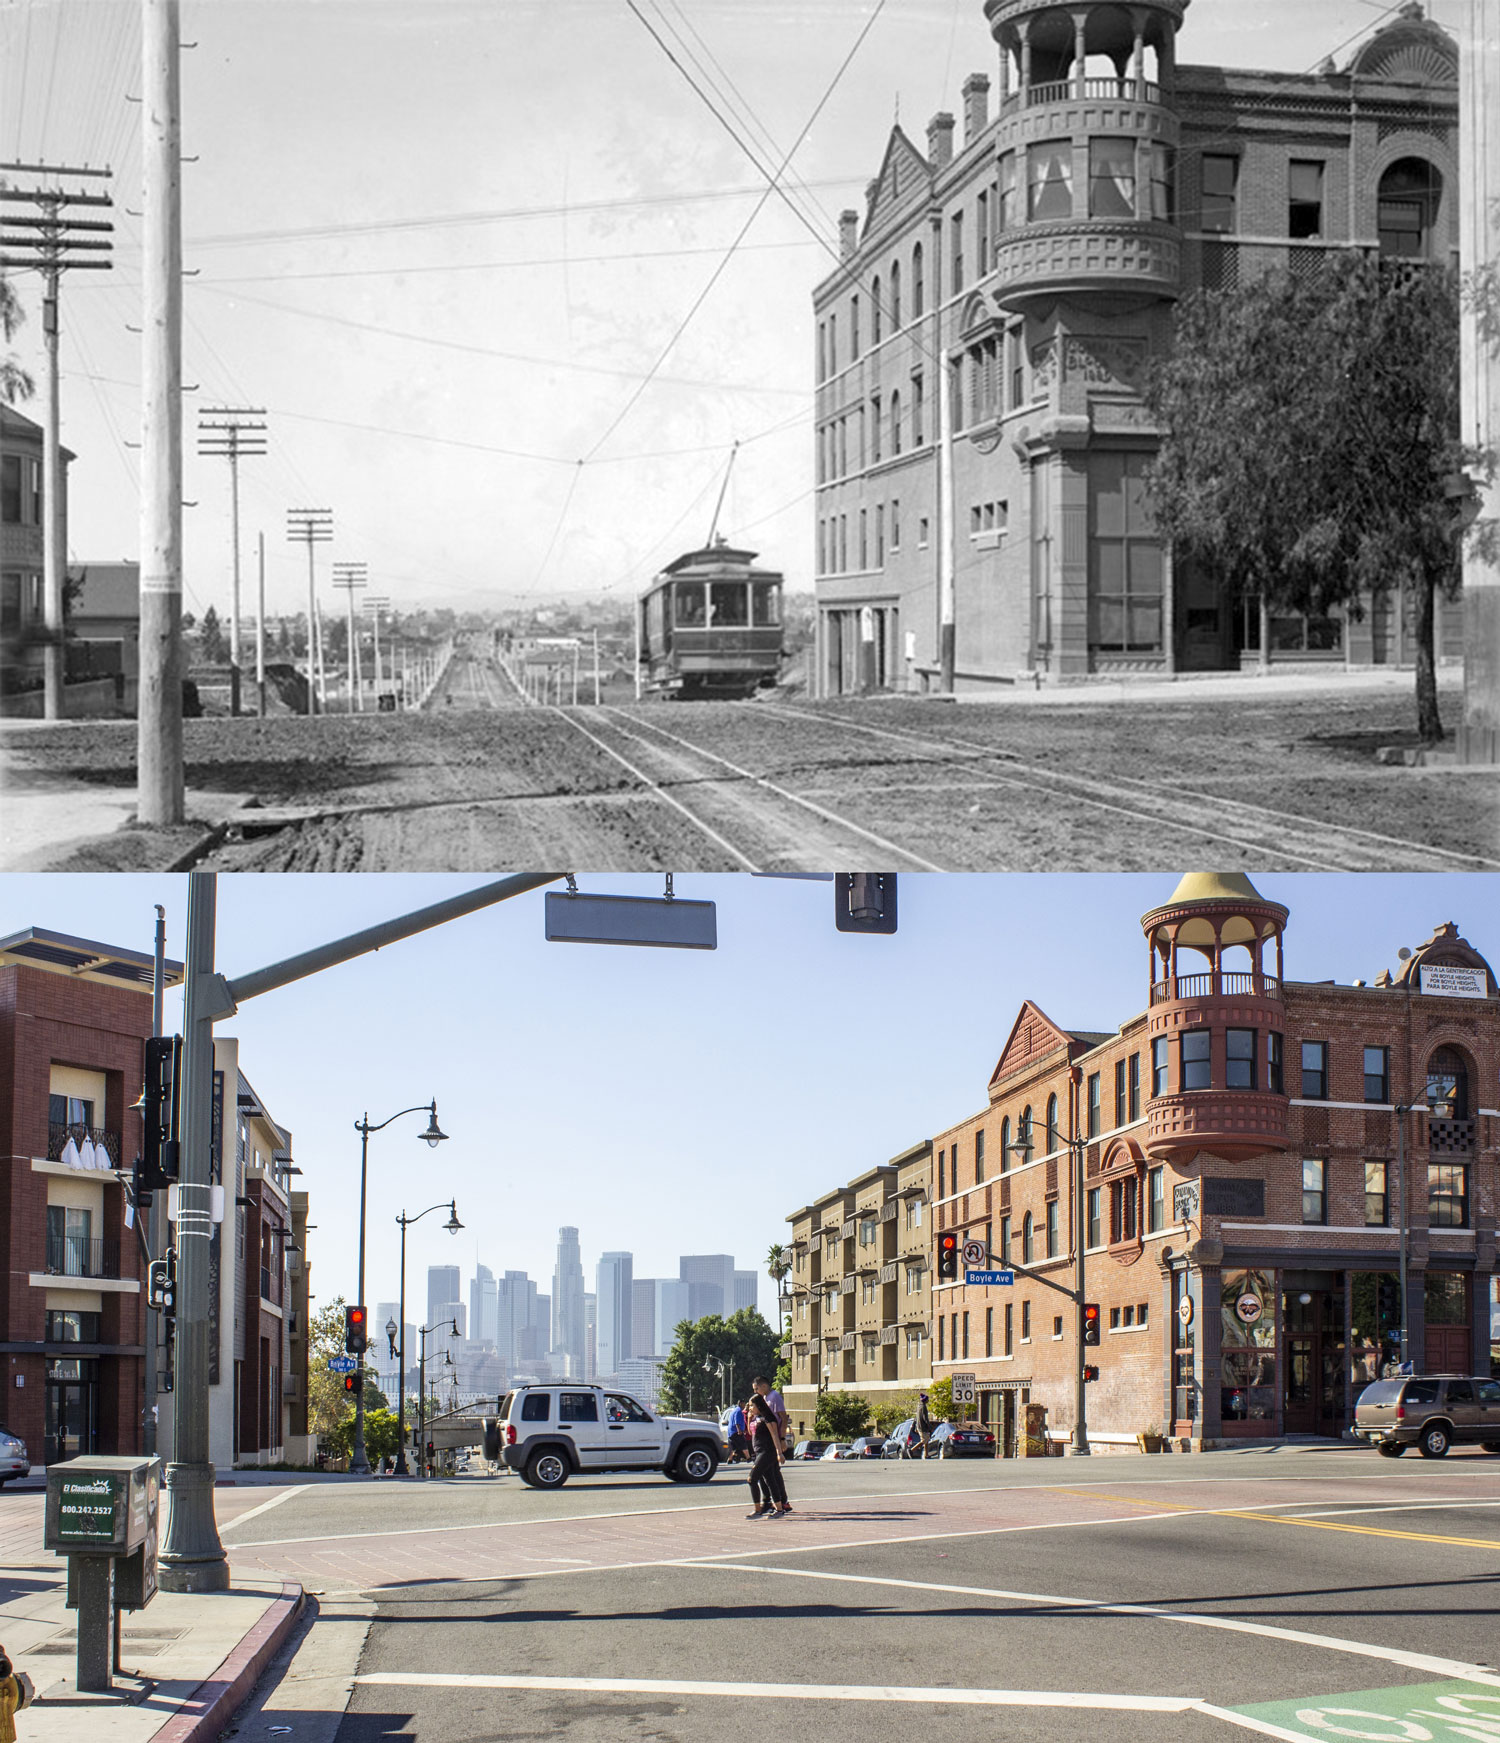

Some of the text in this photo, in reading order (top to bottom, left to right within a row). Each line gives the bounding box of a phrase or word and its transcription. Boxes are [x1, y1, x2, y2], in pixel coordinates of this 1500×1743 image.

[970, 1273, 1010, 1284] Boyle Ave
[955, 1390, 973, 1401] 30
[63, 1484, 106, 1493] El Clasificado
[61, 1505, 112, 1515] 800.242.2527
